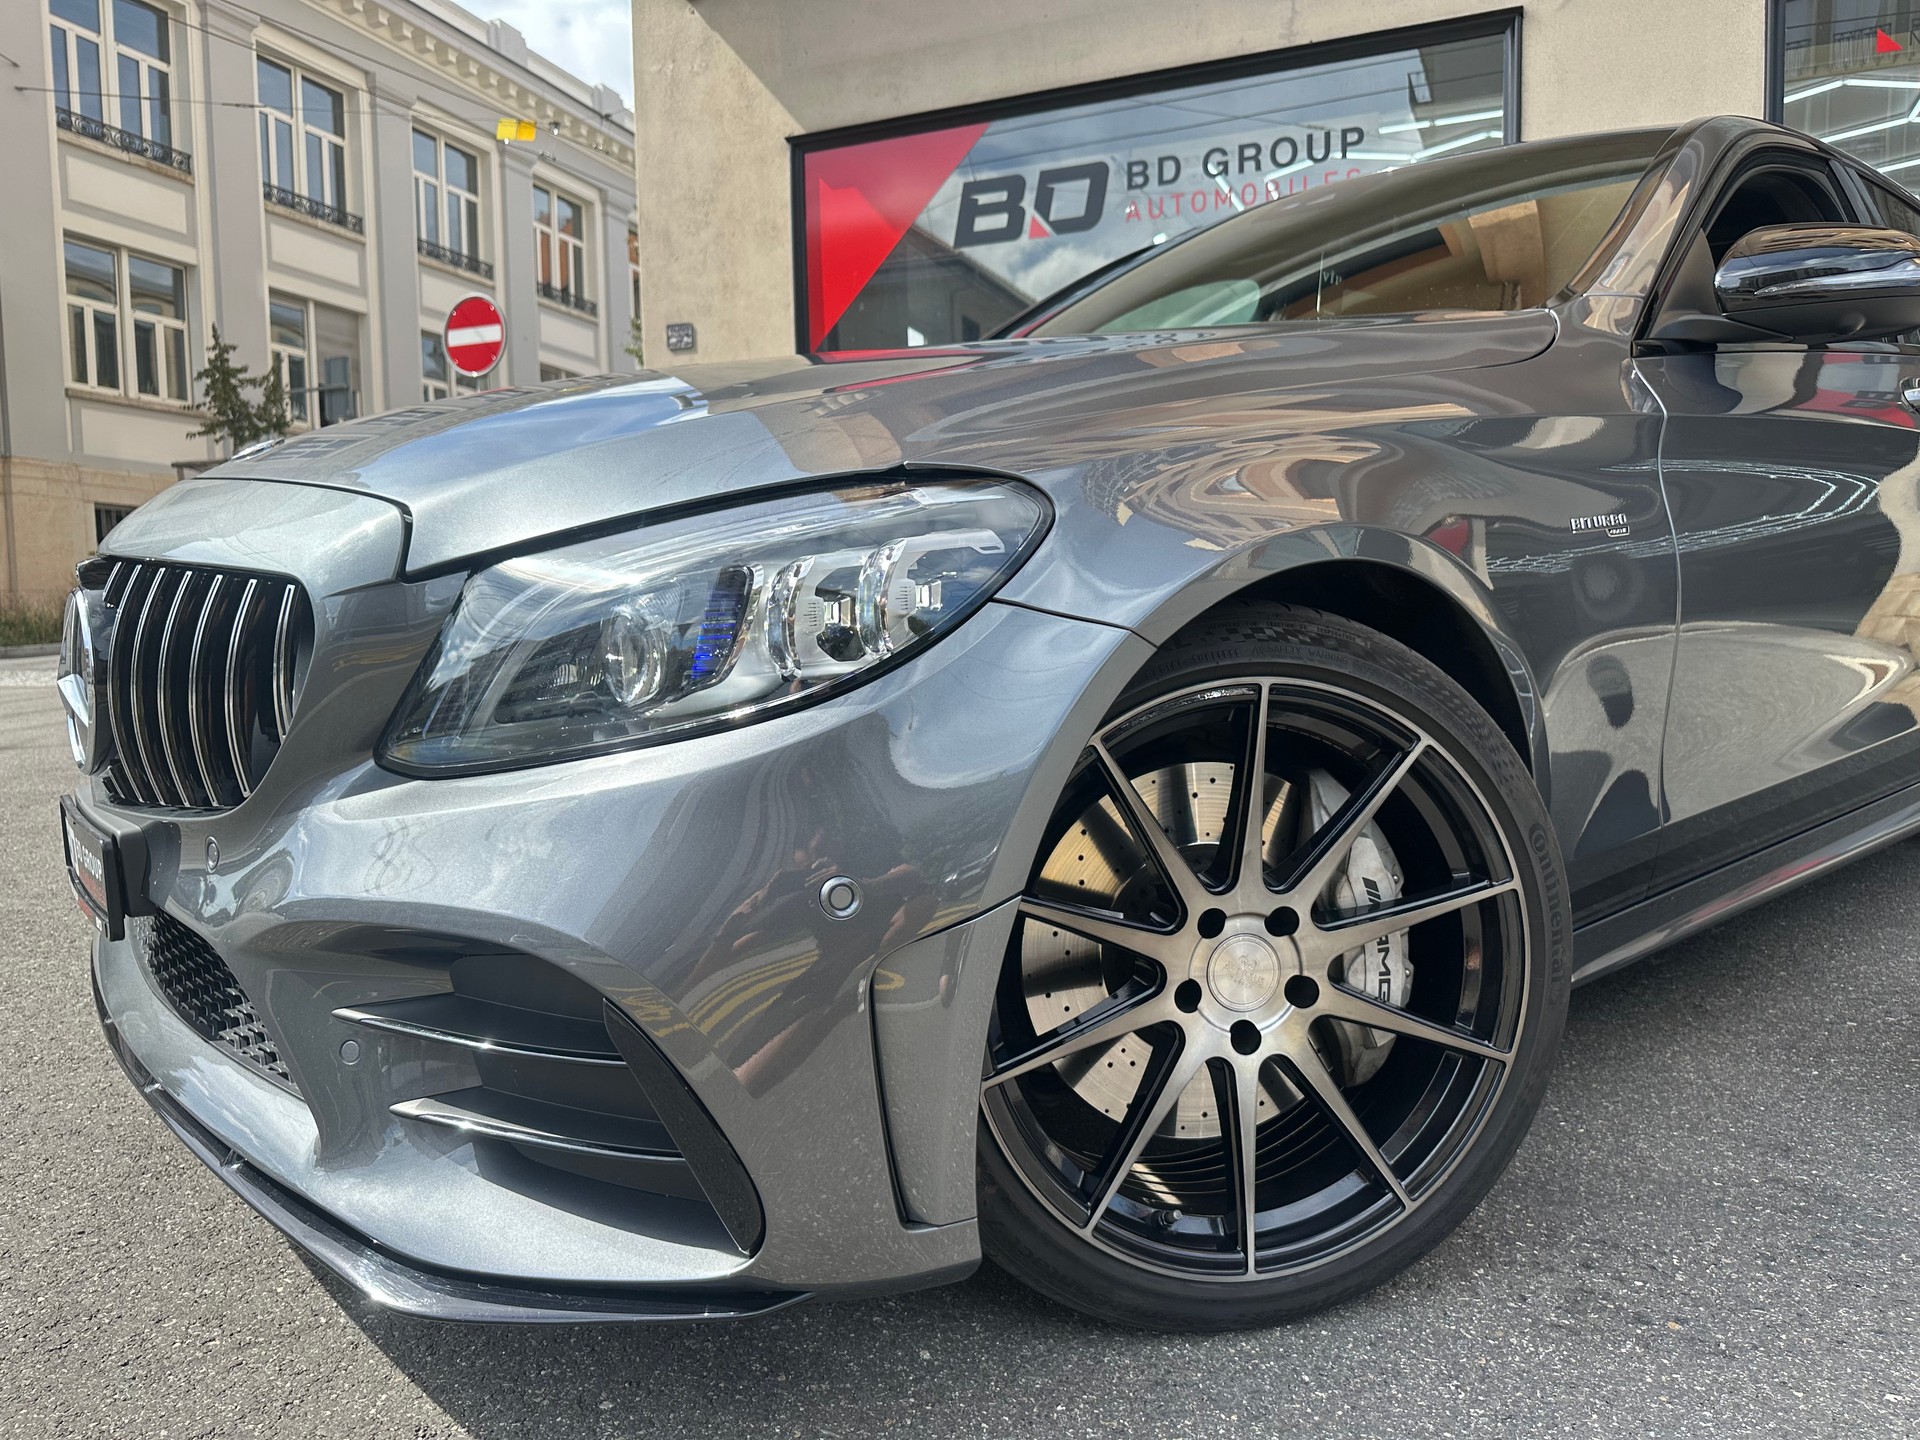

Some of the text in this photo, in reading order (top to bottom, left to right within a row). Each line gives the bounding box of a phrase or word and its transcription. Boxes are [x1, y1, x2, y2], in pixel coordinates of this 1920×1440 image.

[1126, 126, 1364, 191] BD GROUP
[953, 161, 1109, 248] BD
[1528, 822, 1566, 984] Continental
